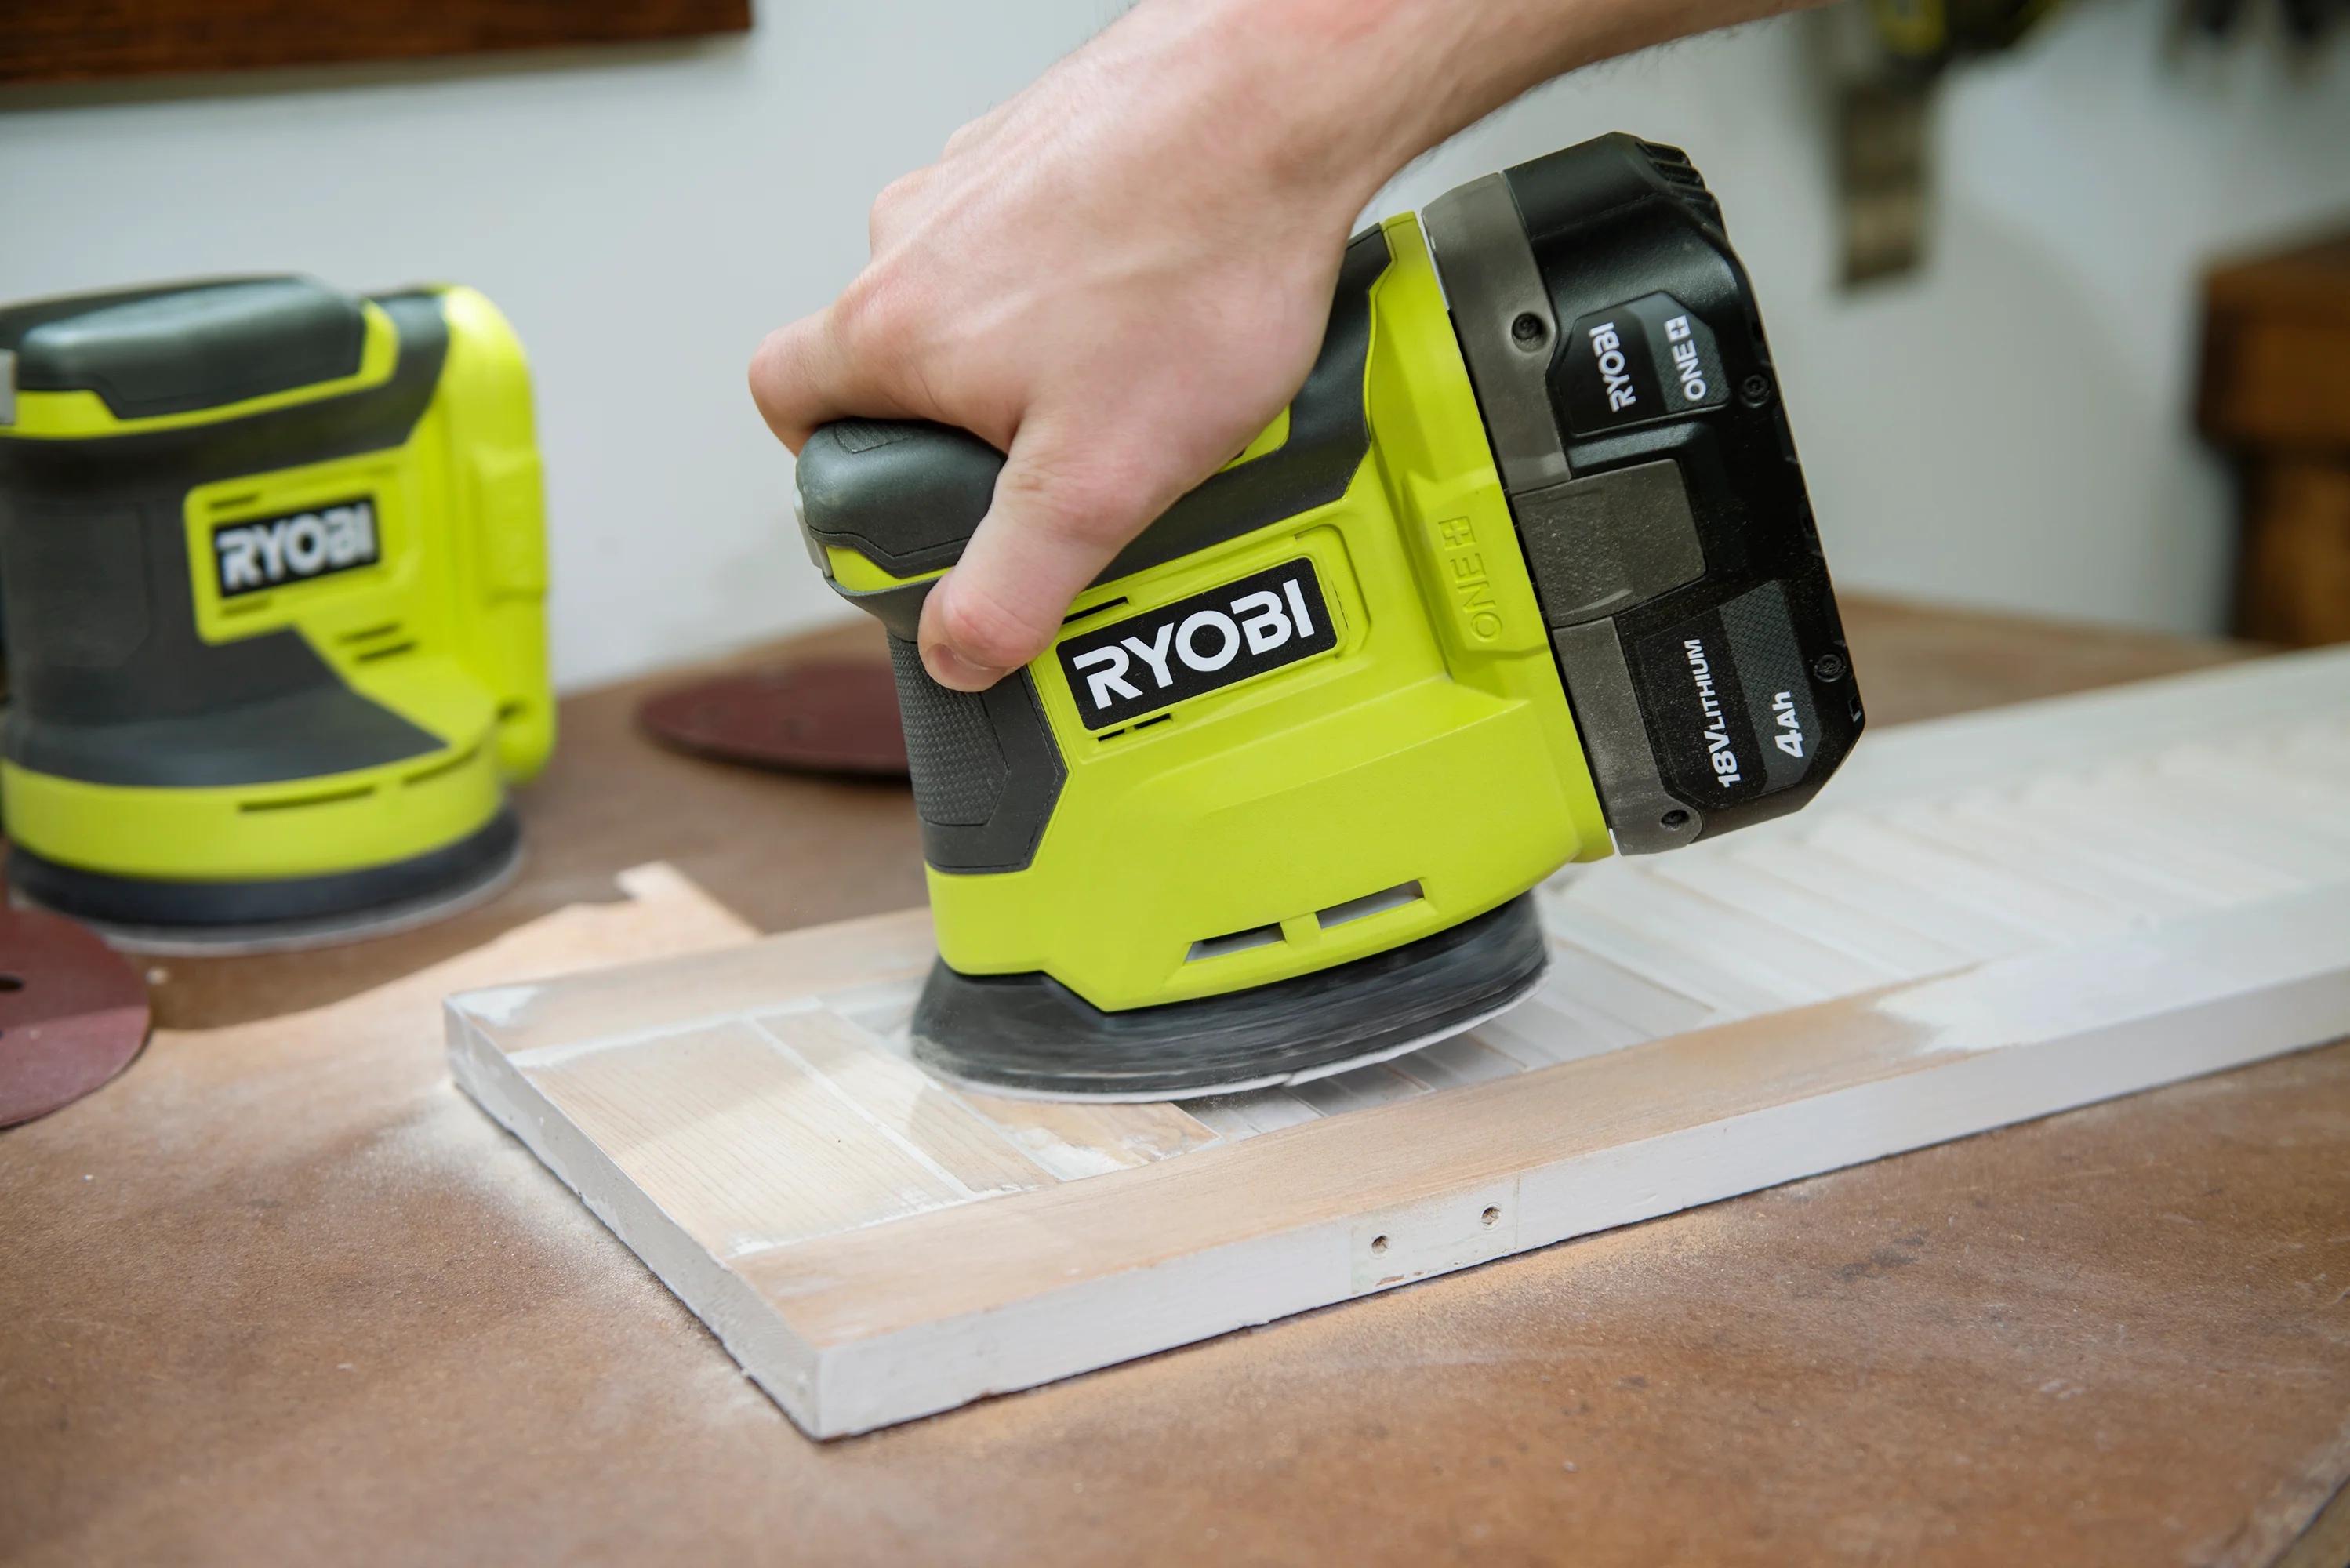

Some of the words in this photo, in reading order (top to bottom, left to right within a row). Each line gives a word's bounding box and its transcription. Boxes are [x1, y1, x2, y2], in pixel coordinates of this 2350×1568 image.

[1589, 321, 1636, 412] RYOBI
[216, 501, 374, 589] RYOBI
[1073, 579, 1315, 710] RYOBI
[1771, 691, 1804, 758] 4Ah
